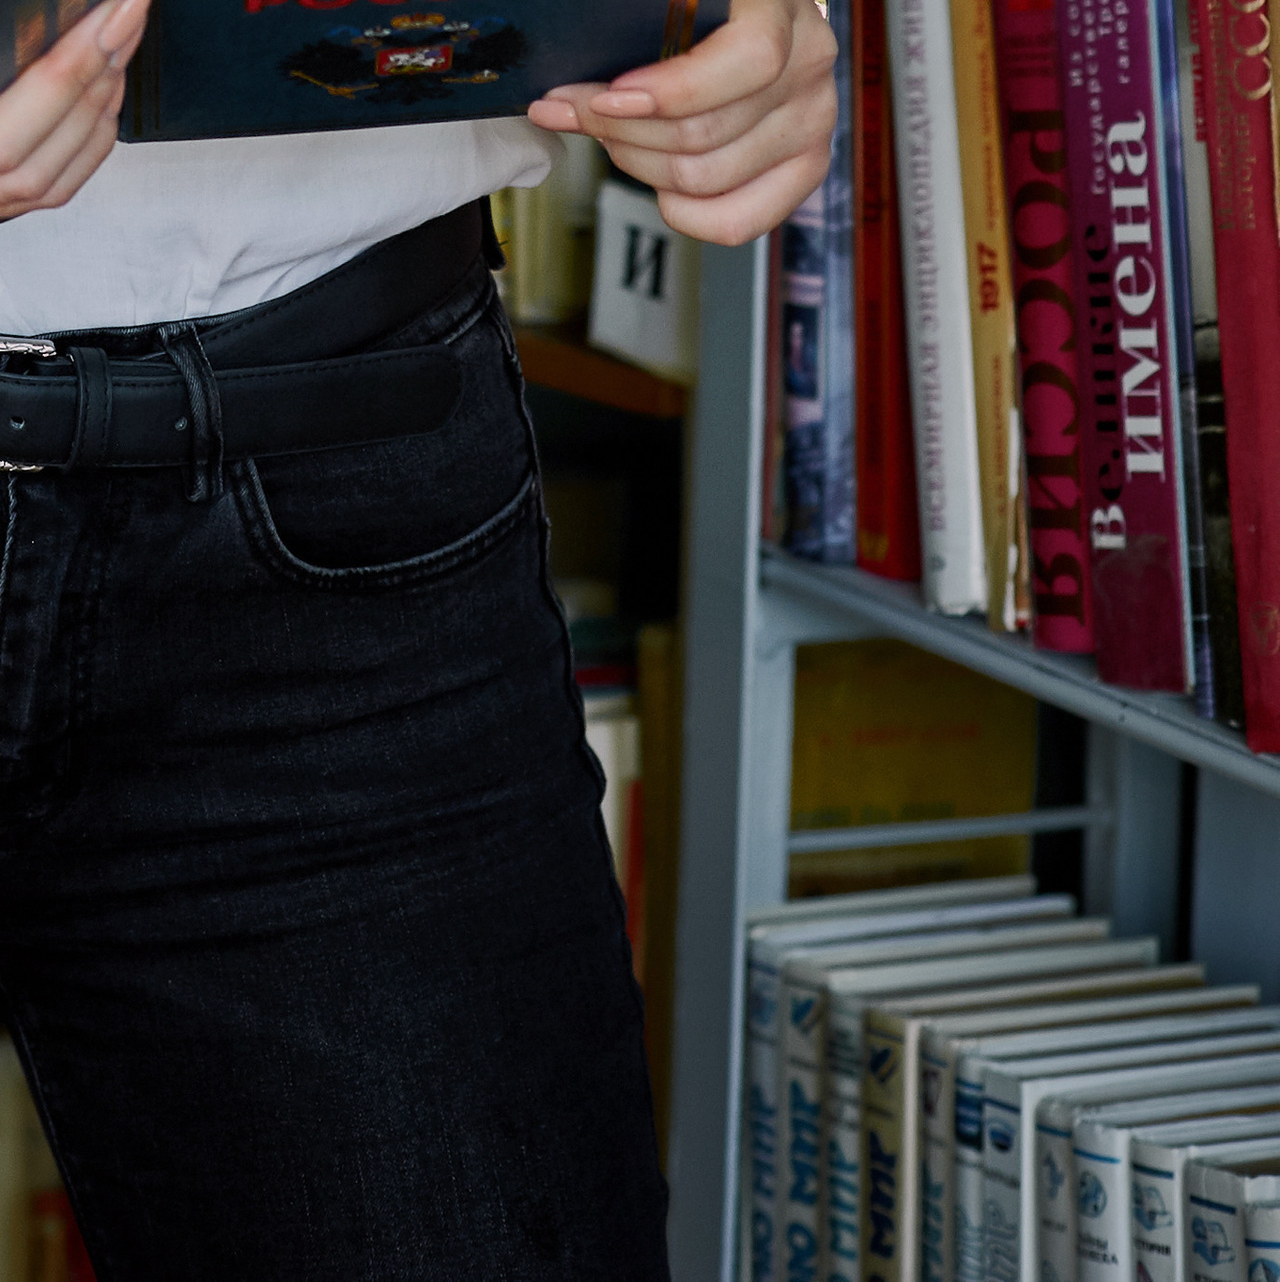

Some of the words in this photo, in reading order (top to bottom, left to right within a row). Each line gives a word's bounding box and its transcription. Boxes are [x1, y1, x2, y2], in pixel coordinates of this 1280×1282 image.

[621, 224, 667, 300] И
[976, 241, 1001, 316] 1917
[1009, 108, 1086, 627] РОССИЯ
[1083, 224, 1129, 550] Великие
[1106, 109, 1167, 483] имена
